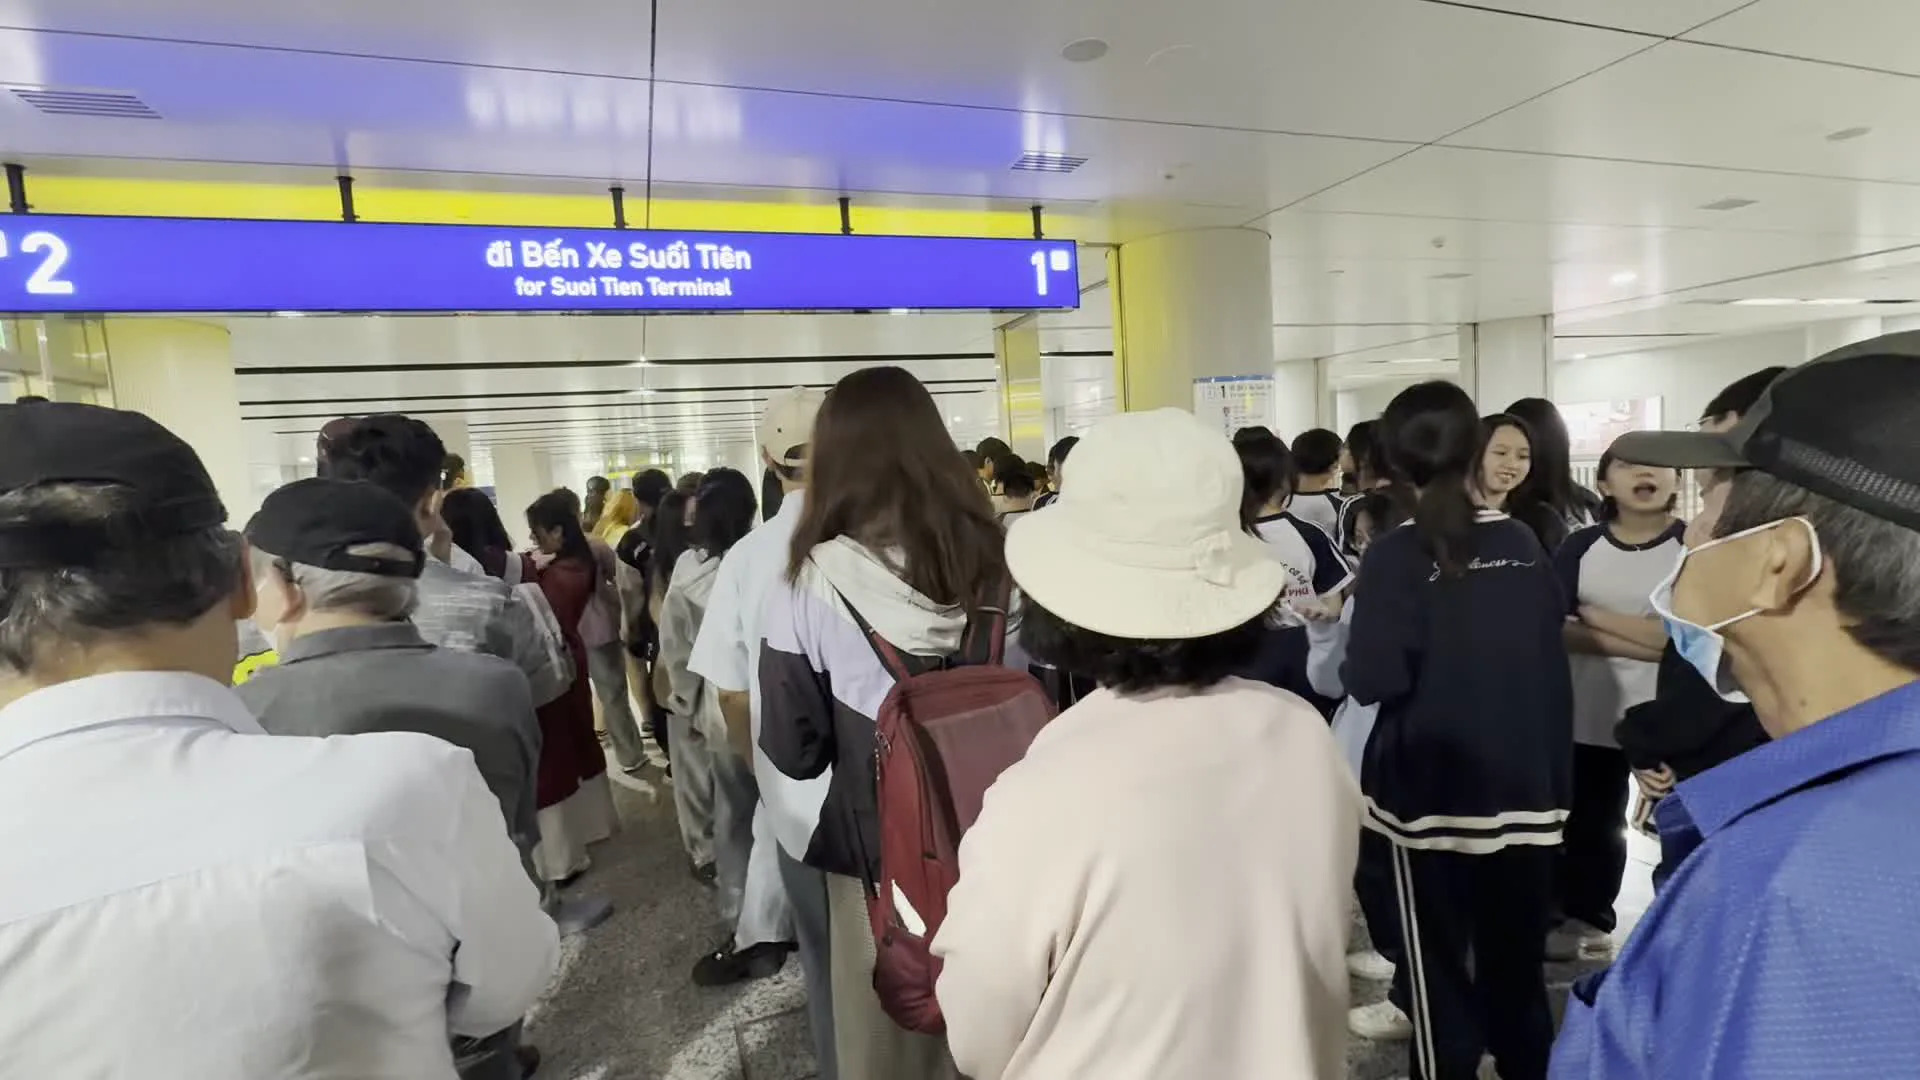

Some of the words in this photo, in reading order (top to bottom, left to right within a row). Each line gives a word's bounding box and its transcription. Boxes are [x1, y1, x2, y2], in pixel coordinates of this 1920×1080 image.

[20, 231, 74, 294] 2
[486, 239, 513, 268] đi
[520, 238, 580, 268] Bến
[584, 241, 622, 269] Xe
[694, 242, 752, 270] Tiên
[1030, 250, 1047, 296] 1
[514, 276, 546, 296] for
[550, 276, 597, 297] Suoi
[599, 276, 643, 297] Tien
[645, 276, 733, 297] Terminal
